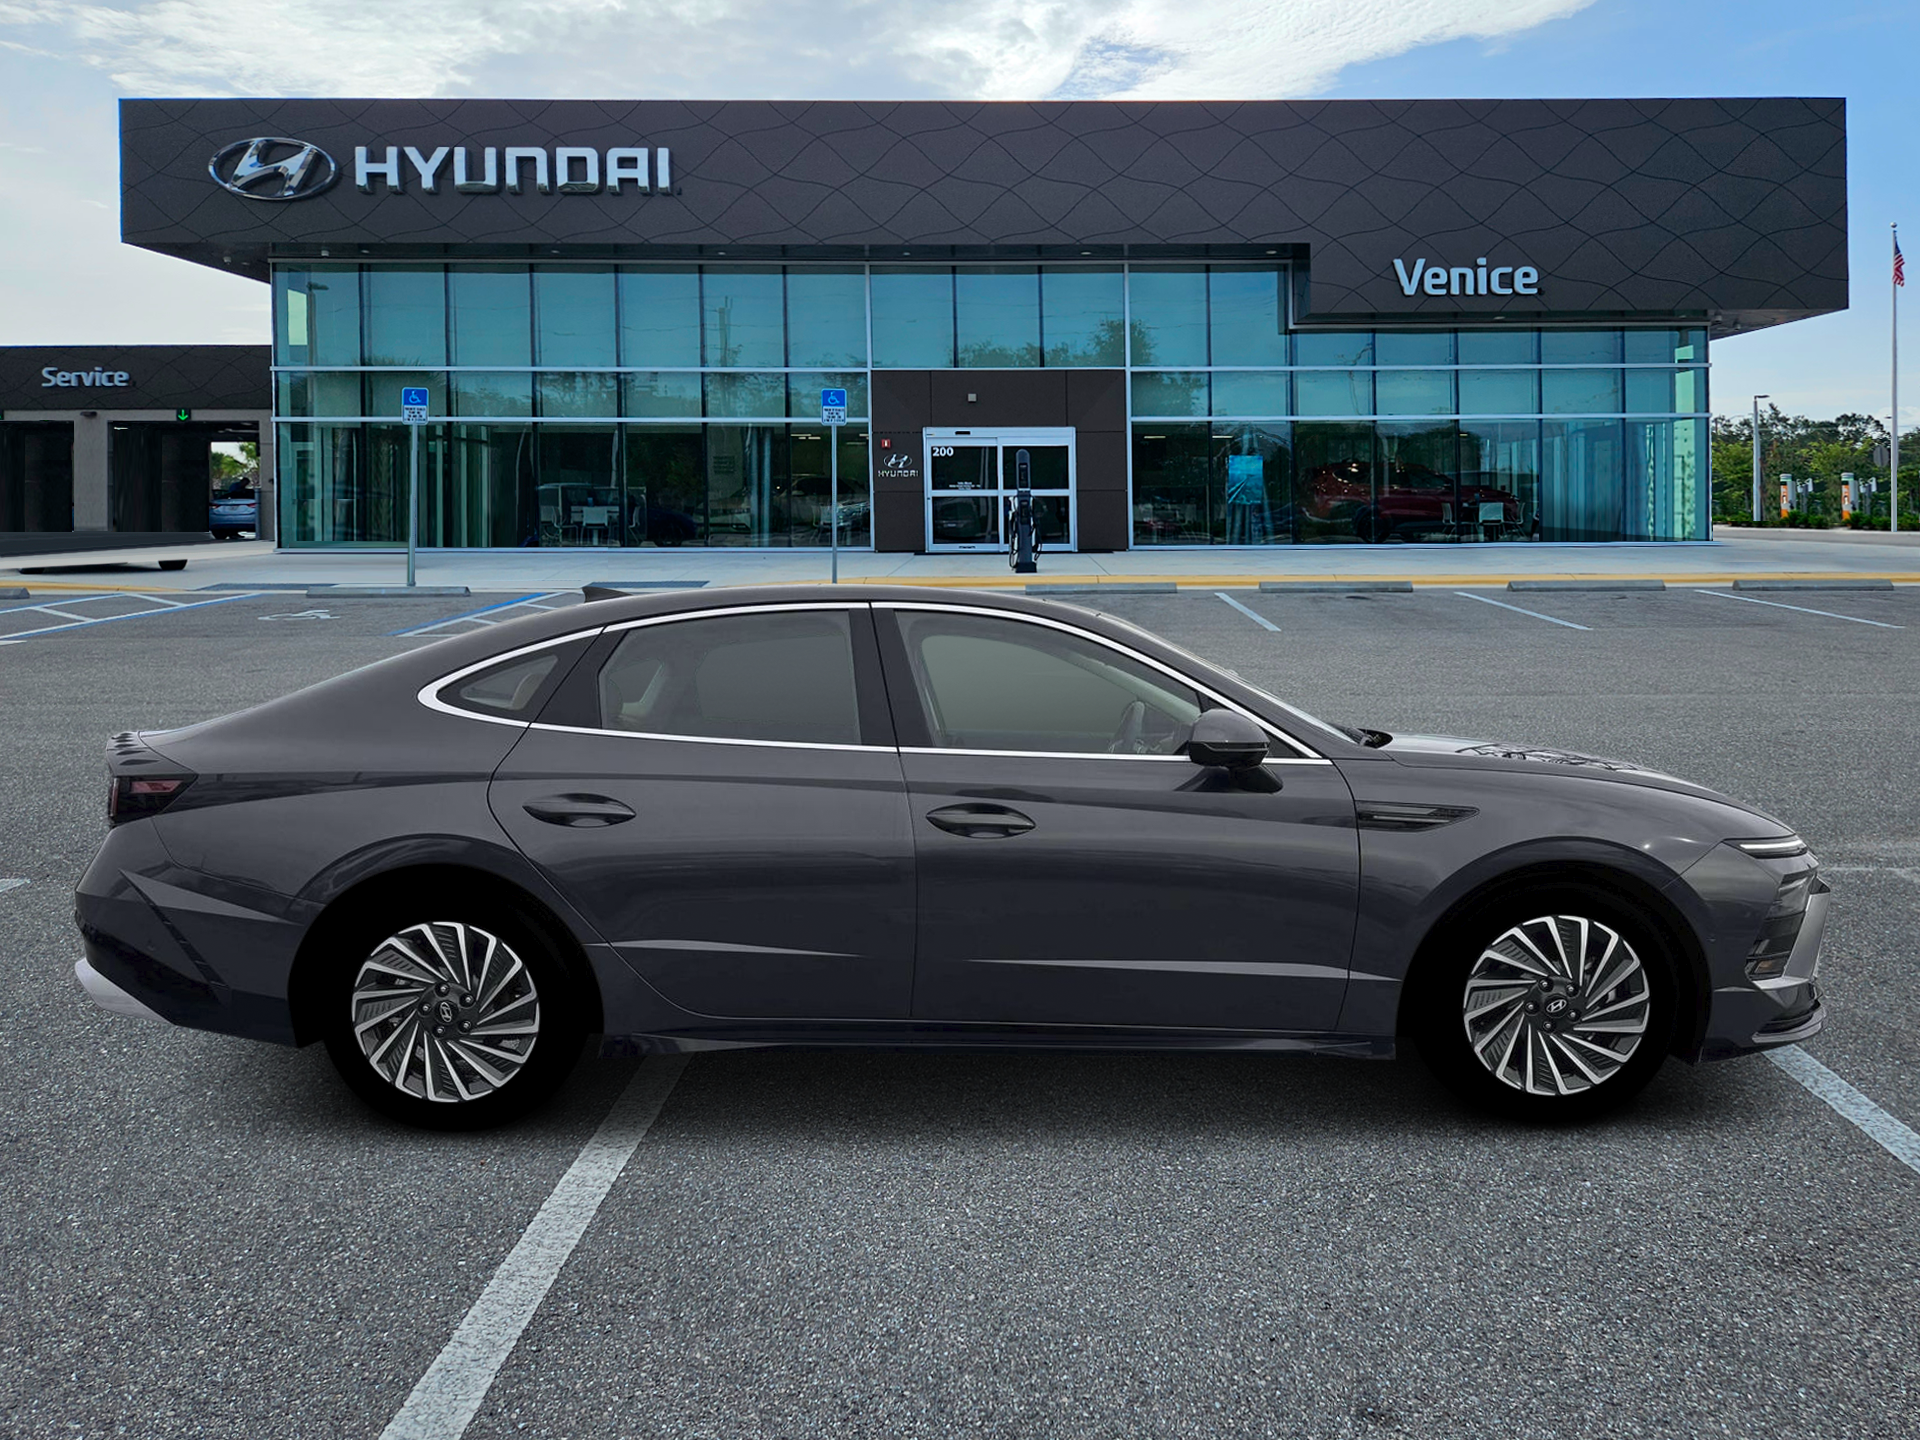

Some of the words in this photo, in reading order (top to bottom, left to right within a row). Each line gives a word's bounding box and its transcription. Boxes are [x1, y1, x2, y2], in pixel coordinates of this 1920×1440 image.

[354, 146, 671, 194] HYUNDAI
[1393, 257, 1539, 296] Venice
[41, 366, 130, 388] Service
[932, 446, 954, 457] 200
[877, 469, 919, 478] HYUNDAI
